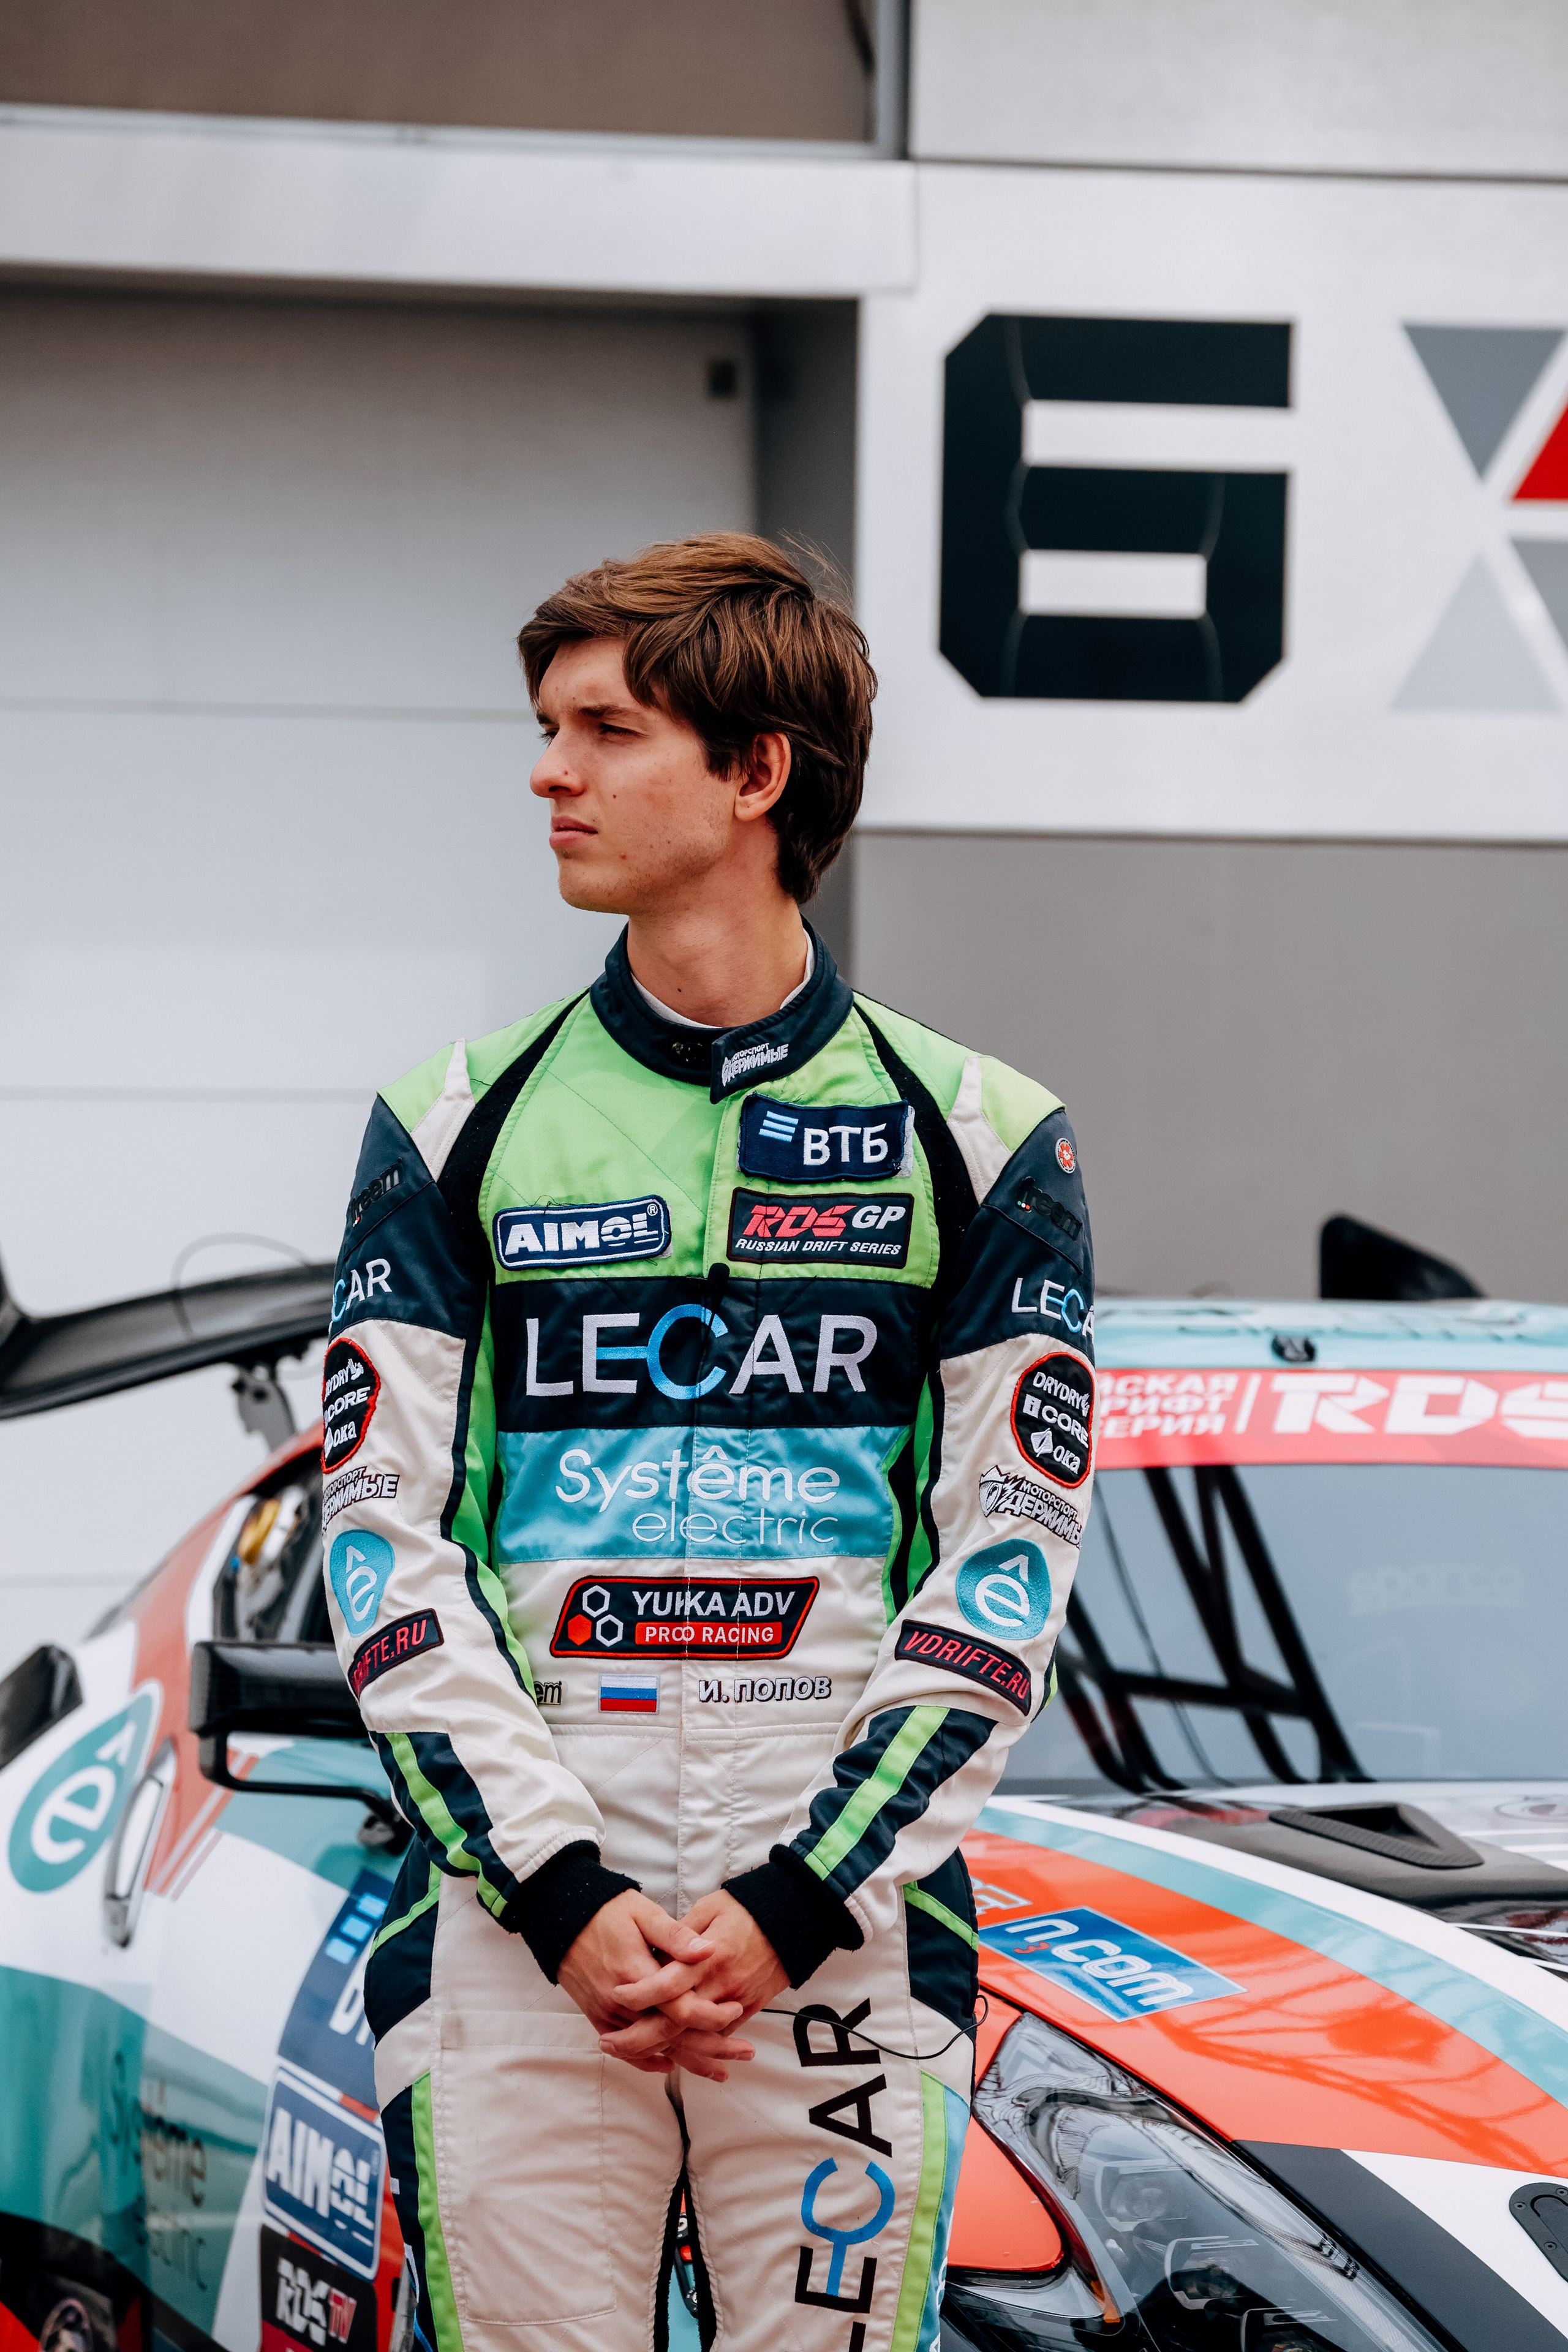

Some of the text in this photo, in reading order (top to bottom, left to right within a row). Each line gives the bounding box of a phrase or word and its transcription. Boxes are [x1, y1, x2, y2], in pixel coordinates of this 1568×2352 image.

[939, 313, 1292, 703] 6
[803, 1123, 888, 1166] ВТБ
[742, 1204, 906, 1238] RDS GP
[735, 1238, 902, 1256] RUSSIAN DRIFT SERIES
[331, 1258, 393, 1322] CAR
[1011, 1278, 1095, 1346] LECA
[526, 1303, 878, 1400] LECAR
[324, 1366, 350, 1403] RYDRY
[1033, 1371, 1082, 1410] DRYDRY
[1099, 1394, 1234, 1419] РИФТ
[1100, 1413, 1226, 1438] ЕРИЯ
[323, 1468, 366, 1500] ОТОРСПОРТ
[1019, 1480, 1078, 1520] МОТОРСПОРТ
[631, 1501, 839, 1545] electric
[731, 1591, 796, 1617] ADV
[352, 1619, 427, 1684] FTE.RU
[702, 1627, 774, 1644] RACING
[903, 1630, 1030, 1700] VDRIFTE.RU
